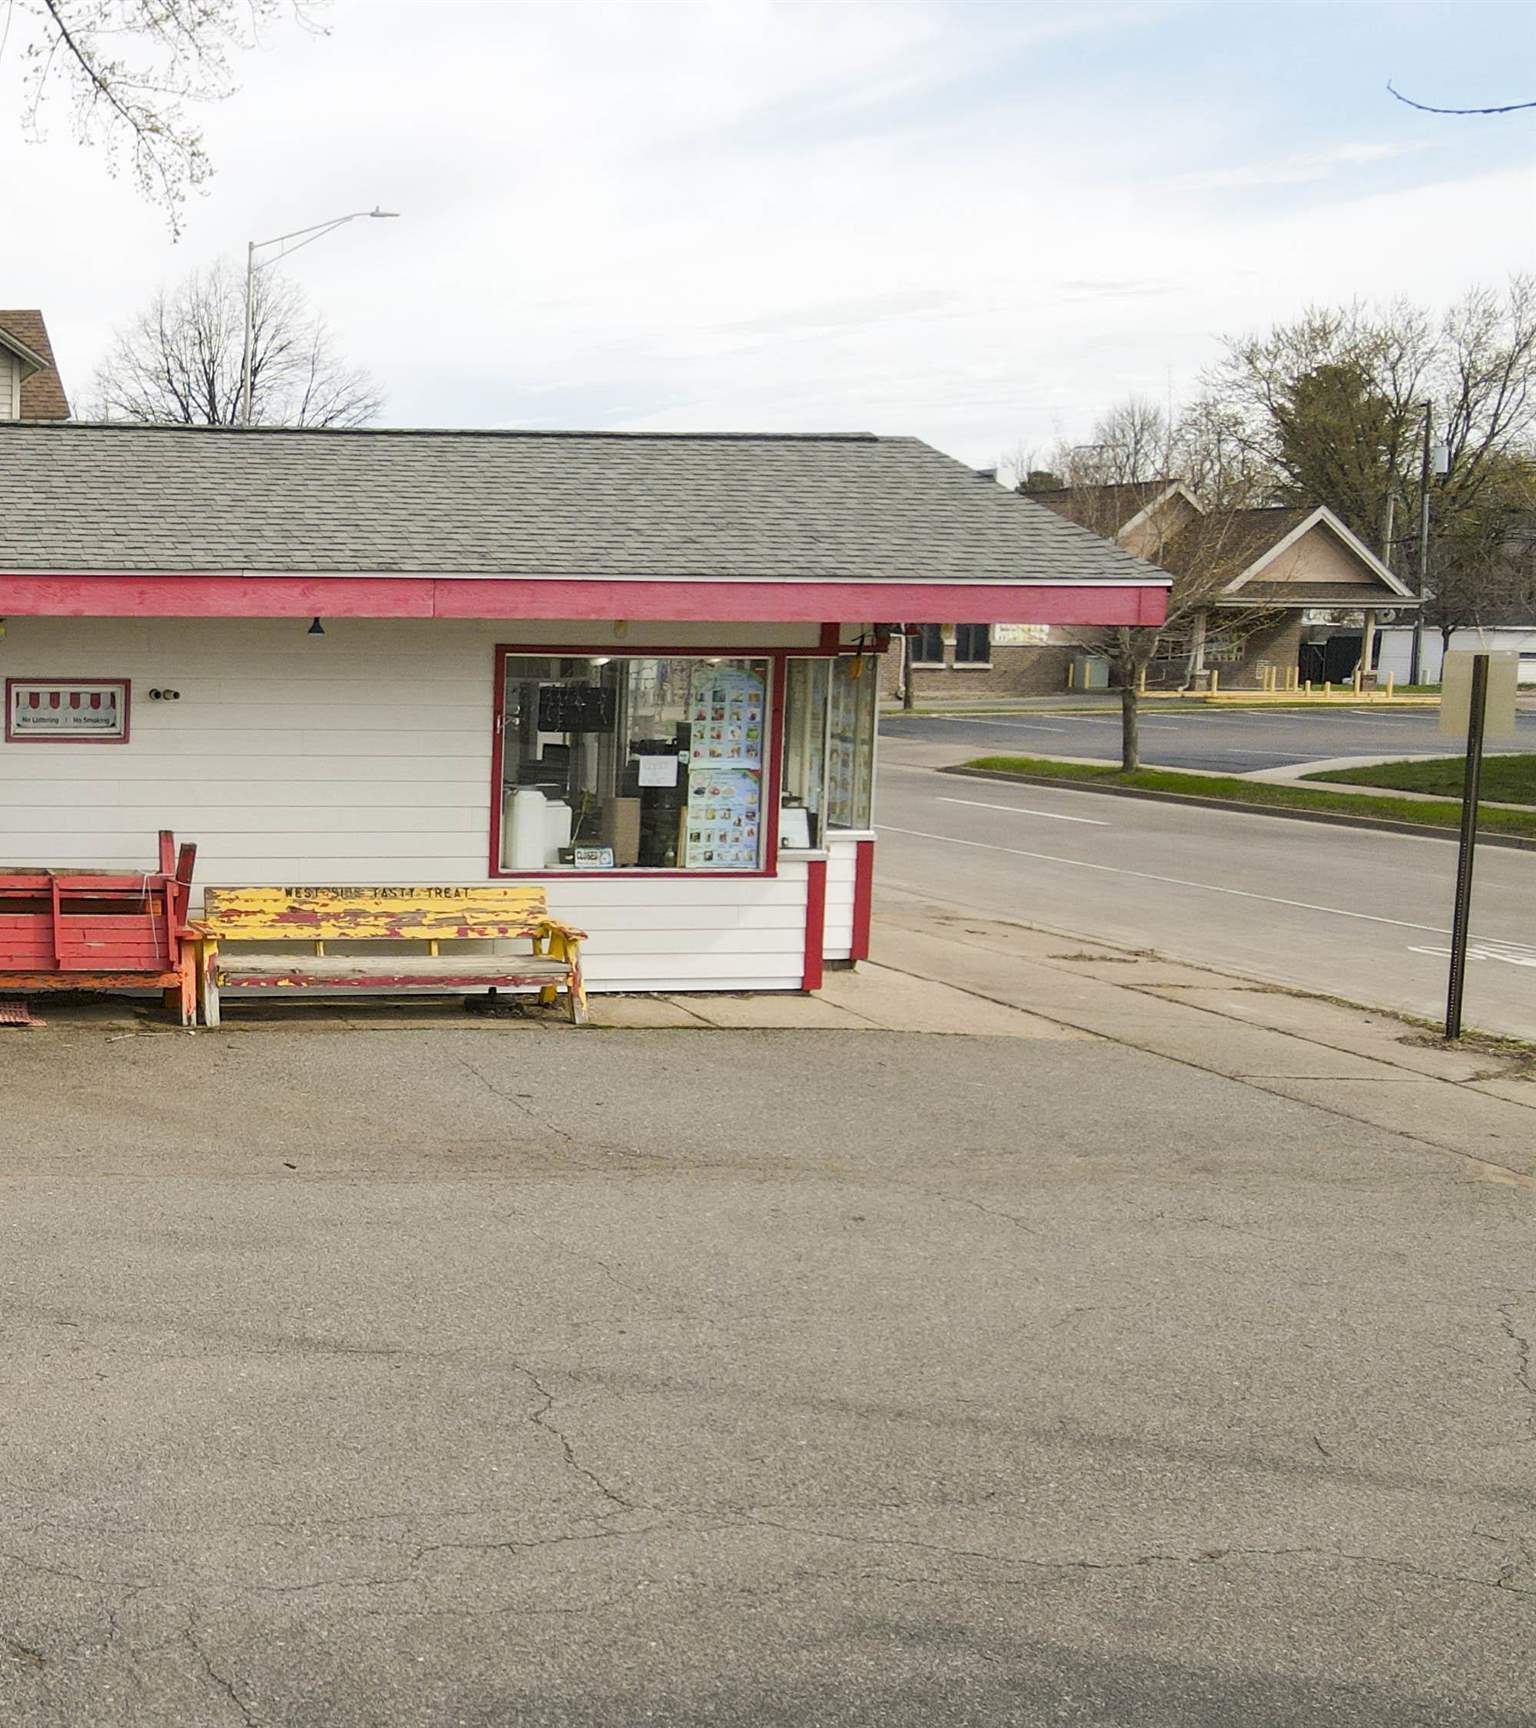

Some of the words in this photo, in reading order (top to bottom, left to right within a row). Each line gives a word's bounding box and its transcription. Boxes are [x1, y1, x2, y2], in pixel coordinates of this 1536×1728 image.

[284, 886, 320, 898] WEST
[372, 886, 415, 898] TASTY
[425, 886, 471, 898] TREAT
